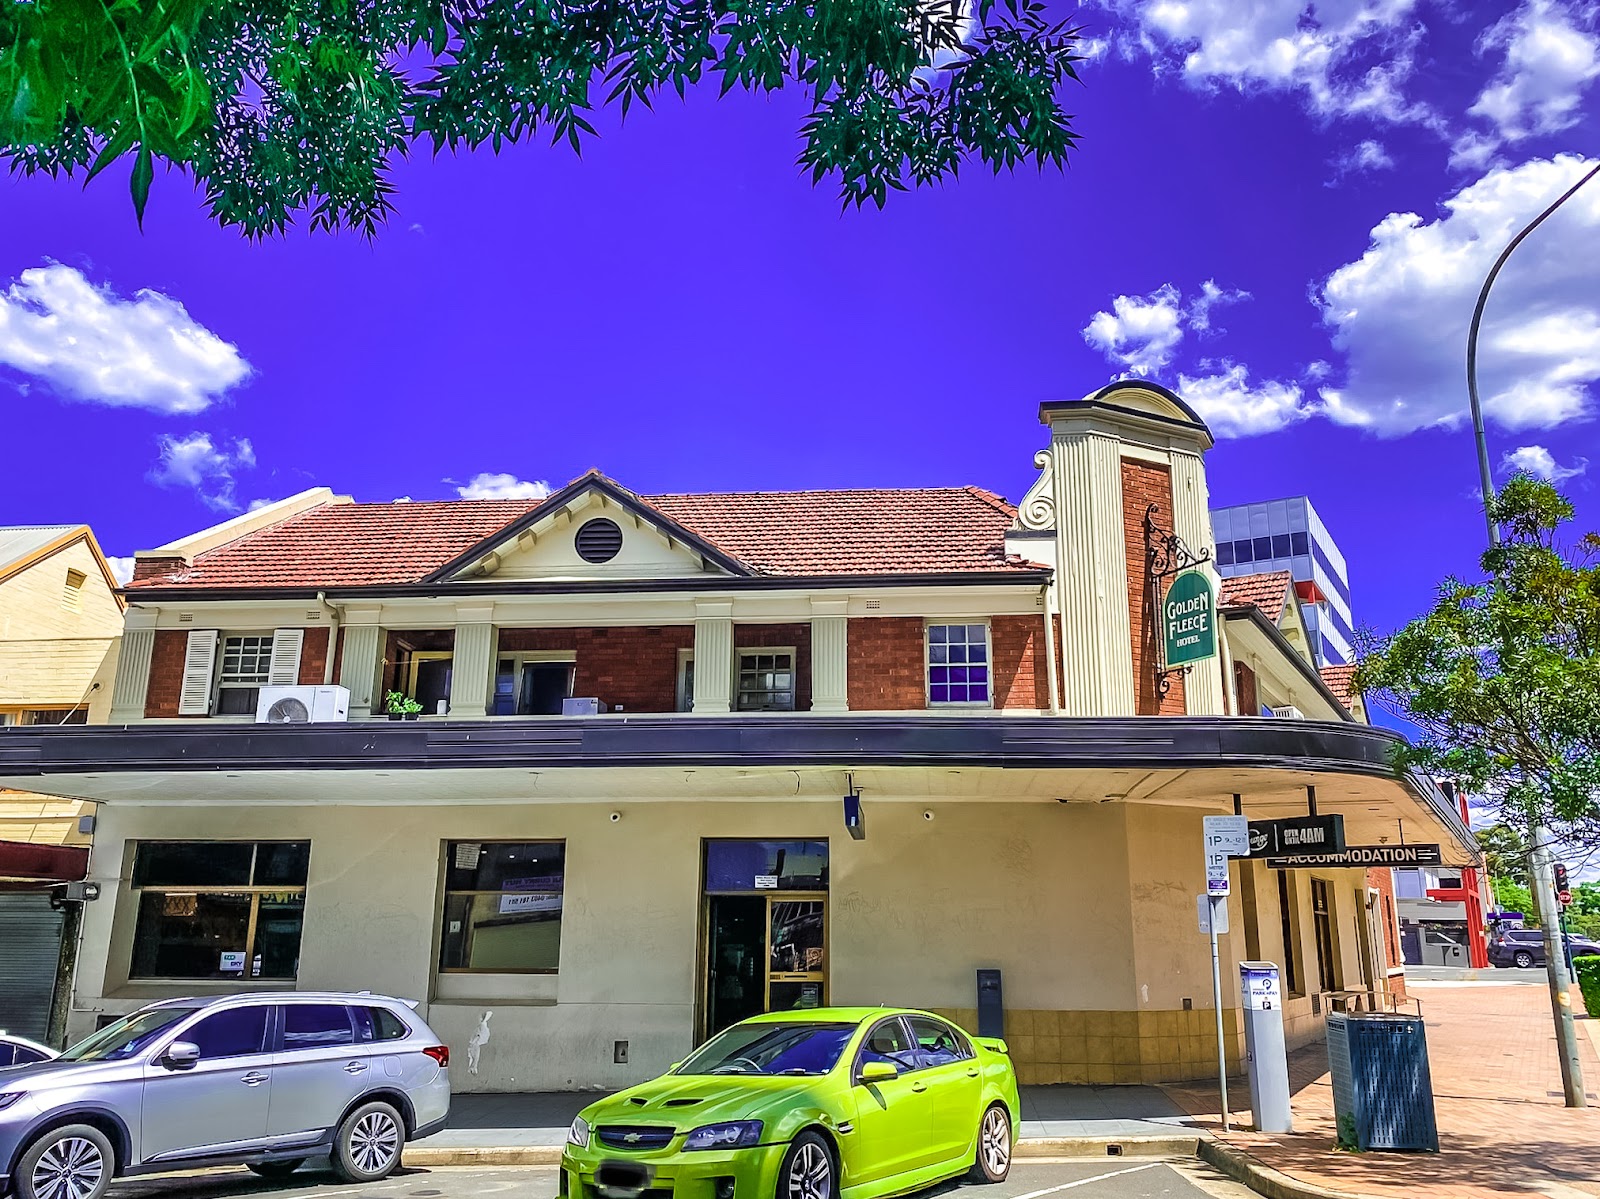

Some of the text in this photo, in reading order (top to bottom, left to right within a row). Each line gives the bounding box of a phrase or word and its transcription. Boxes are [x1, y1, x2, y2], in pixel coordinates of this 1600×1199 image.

[1169, 613, 1208, 640] FLEECE
[1176, 634, 1200, 647] HOTEL
[1284, 828, 1299, 837] OPEN
[1300, 827, 1325, 844] 4AM
[1208, 836, 1222, 846] 1P
[1209, 854, 1223, 865] 1P
